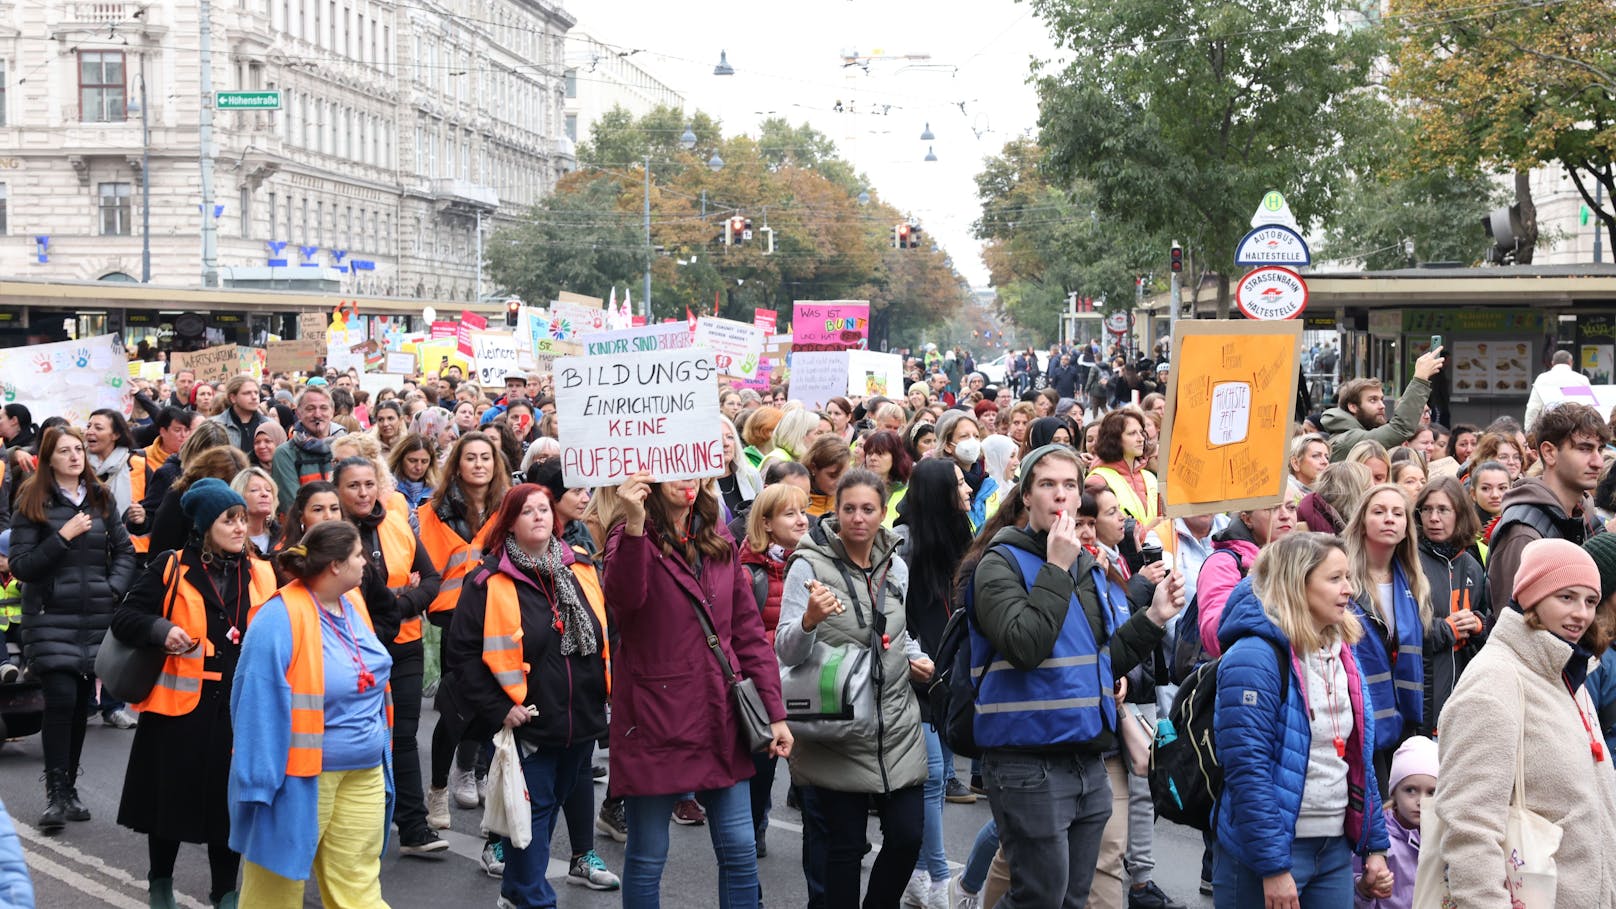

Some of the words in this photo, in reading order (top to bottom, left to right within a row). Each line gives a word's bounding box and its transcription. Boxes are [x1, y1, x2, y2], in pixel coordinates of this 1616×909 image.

[228, 95, 277, 105] Höhenstraße
[1268, 195, 1279, 208] H
[1253, 230, 1295, 246] AUTOBUS
[1245, 252, 1300, 261] HALTESTELLE
[1245, 273, 1300, 293] STRASSENBAHN
[801, 307, 820, 318] WAS
[827, 309, 841, 318] IST
[1246, 300, 1297, 318] HALTESTELLE
[826, 317, 867, 332] BUNT
[588, 338, 628, 356] KINDER
[632, 335, 657, 353] SIND
[561, 359, 715, 389] BILDUNGS-
[583, 392, 696, 416] EINRICHTUNG
[609, 417, 667, 437] KEINE
[564, 440, 723, 478] AUFBEWAHRUNG
